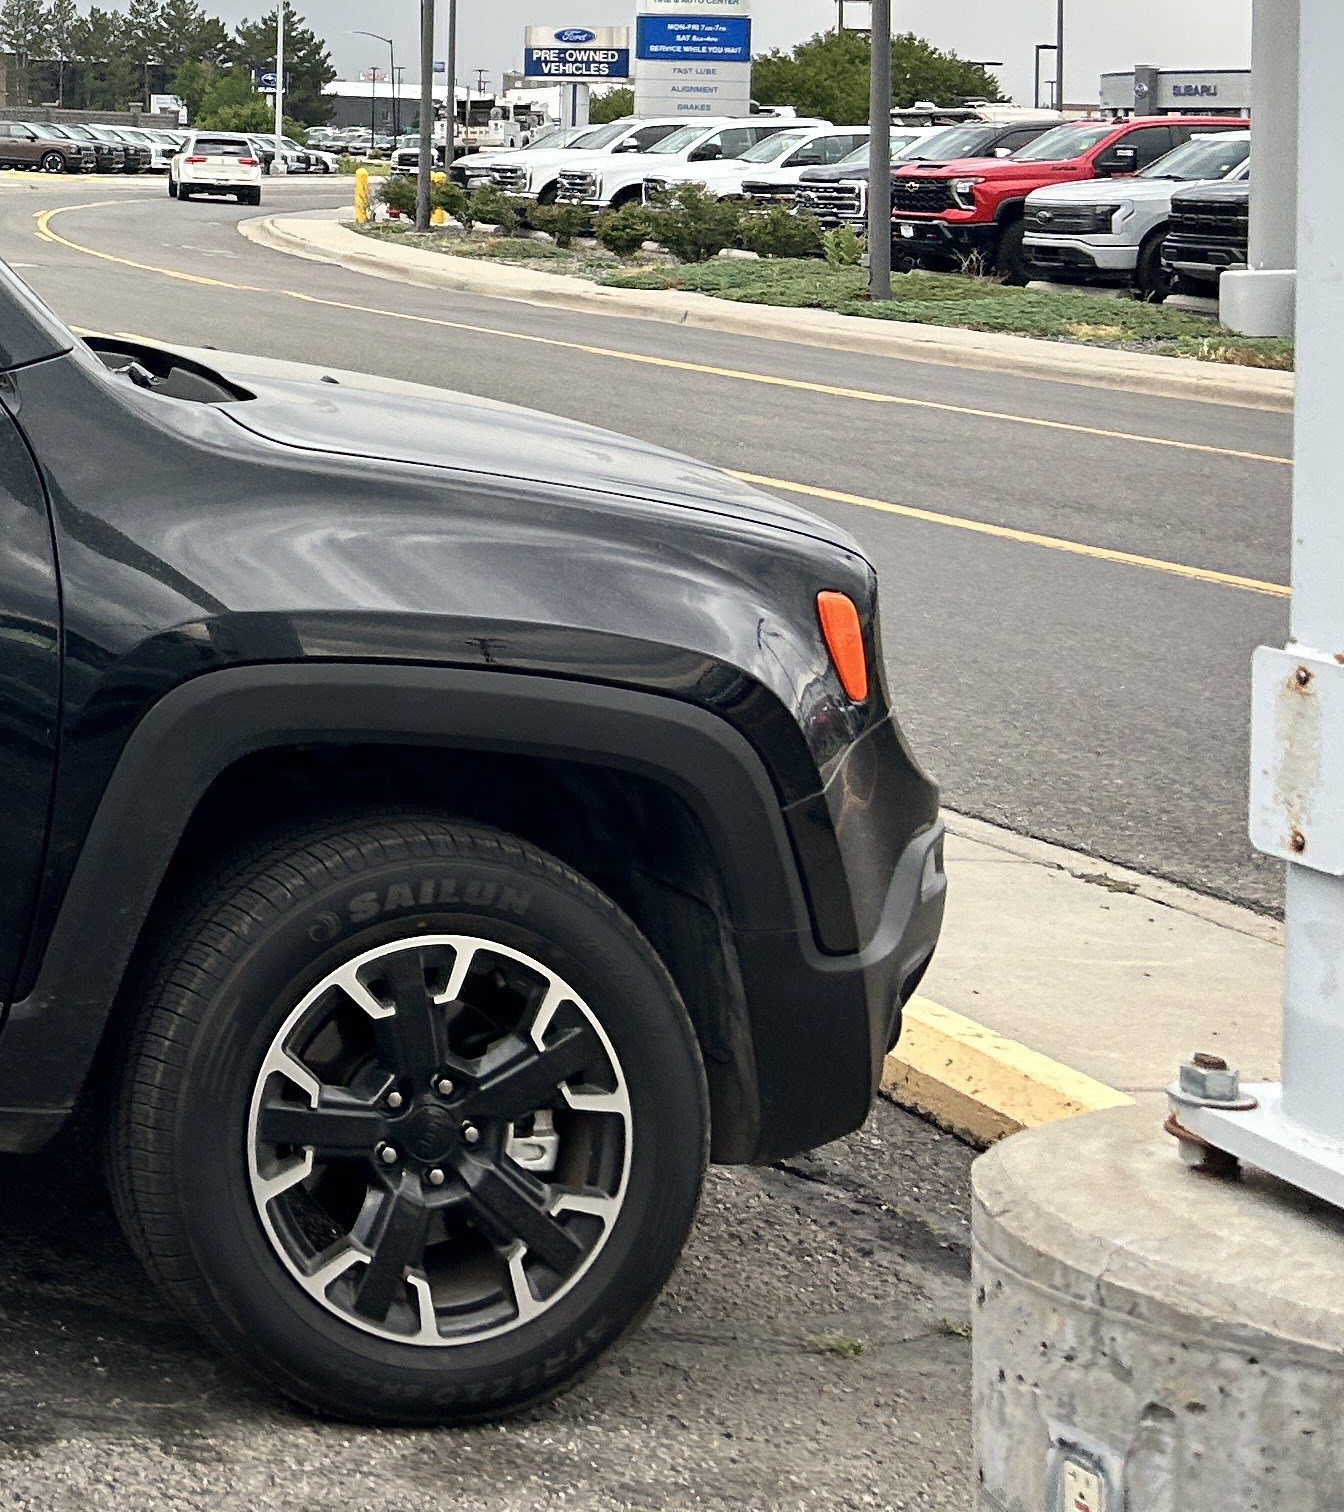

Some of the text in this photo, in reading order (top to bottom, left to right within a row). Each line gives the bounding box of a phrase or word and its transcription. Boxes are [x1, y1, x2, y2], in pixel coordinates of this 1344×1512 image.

[561, 29, 589, 41] Ford
[532, 49, 619, 62] PRE-OWNED
[541, 62, 610, 75] VEHICLES
[672, 67, 693, 75] FAST
[671, 86, 719, 94] ALIGNMENT
[1172, 84, 1218, 97] SUBARU
[676, 103, 712, 112] BRAKES
[347, 877, 537, 924] SAILUN
